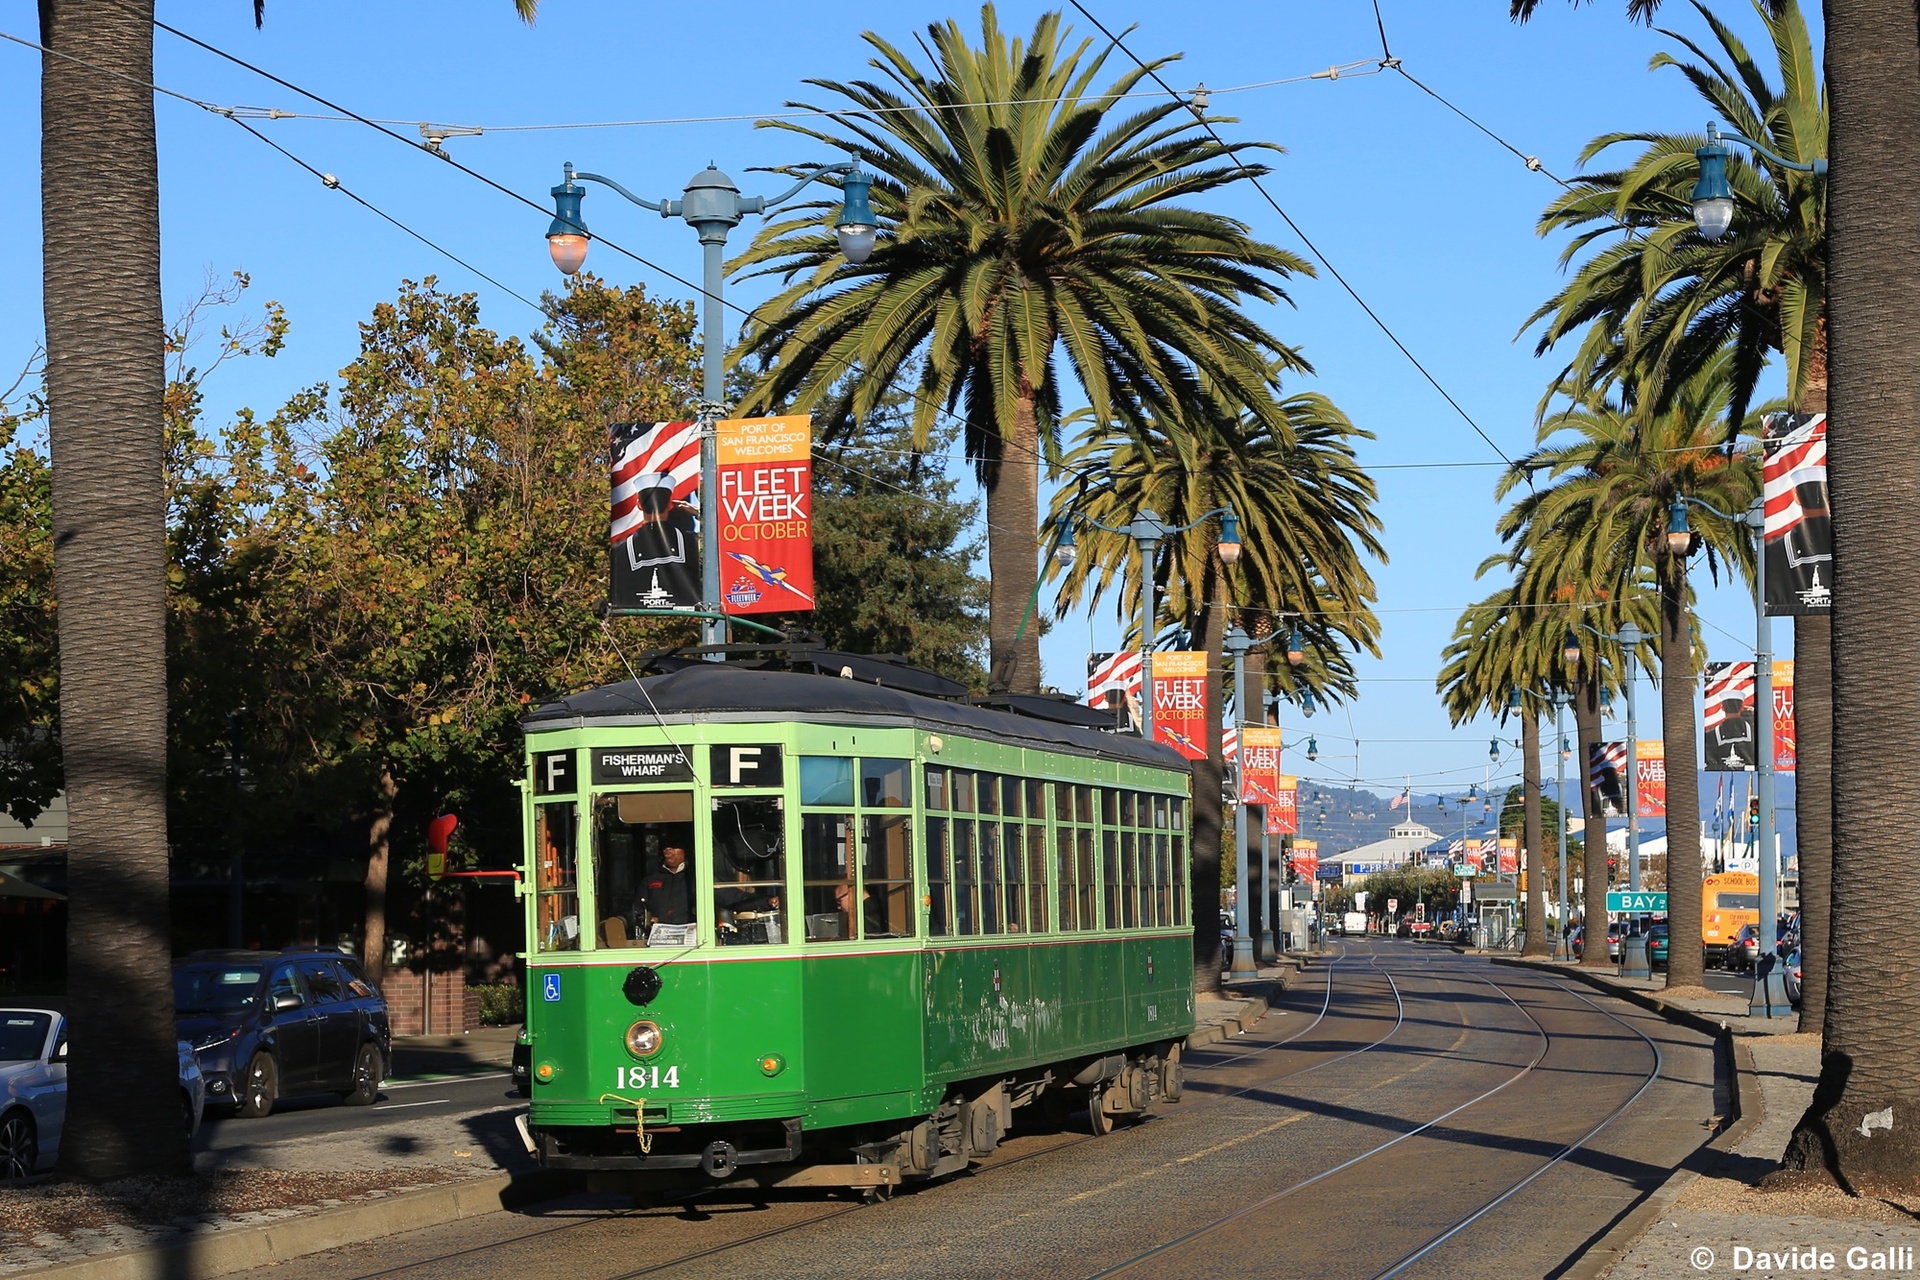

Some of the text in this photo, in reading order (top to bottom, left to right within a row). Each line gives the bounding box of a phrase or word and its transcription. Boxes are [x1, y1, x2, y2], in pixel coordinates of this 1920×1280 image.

[741, 423, 786, 434] PORT OF
[722, 432, 806, 446] SAN FRANCISCO
[735, 444, 793, 456] WELCOMES
[721, 467, 807, 497] FLEET
[722, 493, 808, 523] WEEK
[723, 520, 808, 542] OCTOBER
[1803, 597, 1829, 605] PORT
[1155, 680, 1205, 695] FLEET
[1155, 694, 1205, 710] WEEK
[1155, 710, 1205, 720] OCTOBER
[602, 753, 684, 766] FISHERMAN'S
[1243, 748, 1279, 759] FLEET
[729, 747, 762, 783] F
[1244, 758, 1279, 769] WEEK
[1637, 760, 1665, 772] FLEE
[547, 754, 567, 791] F
[621, 765, 666, 777] WHARF
[1243, 769, 1279, 777] OCTOBER
[1637, 770, 1666, 782] WEE
[1278, 790, 1296, 799] EET
[1724, 877, 1757, 886] SCHOOL BUS
[1621, 895, 1657, 909] BAY
[616, 1065, 680, 1090] 1814
